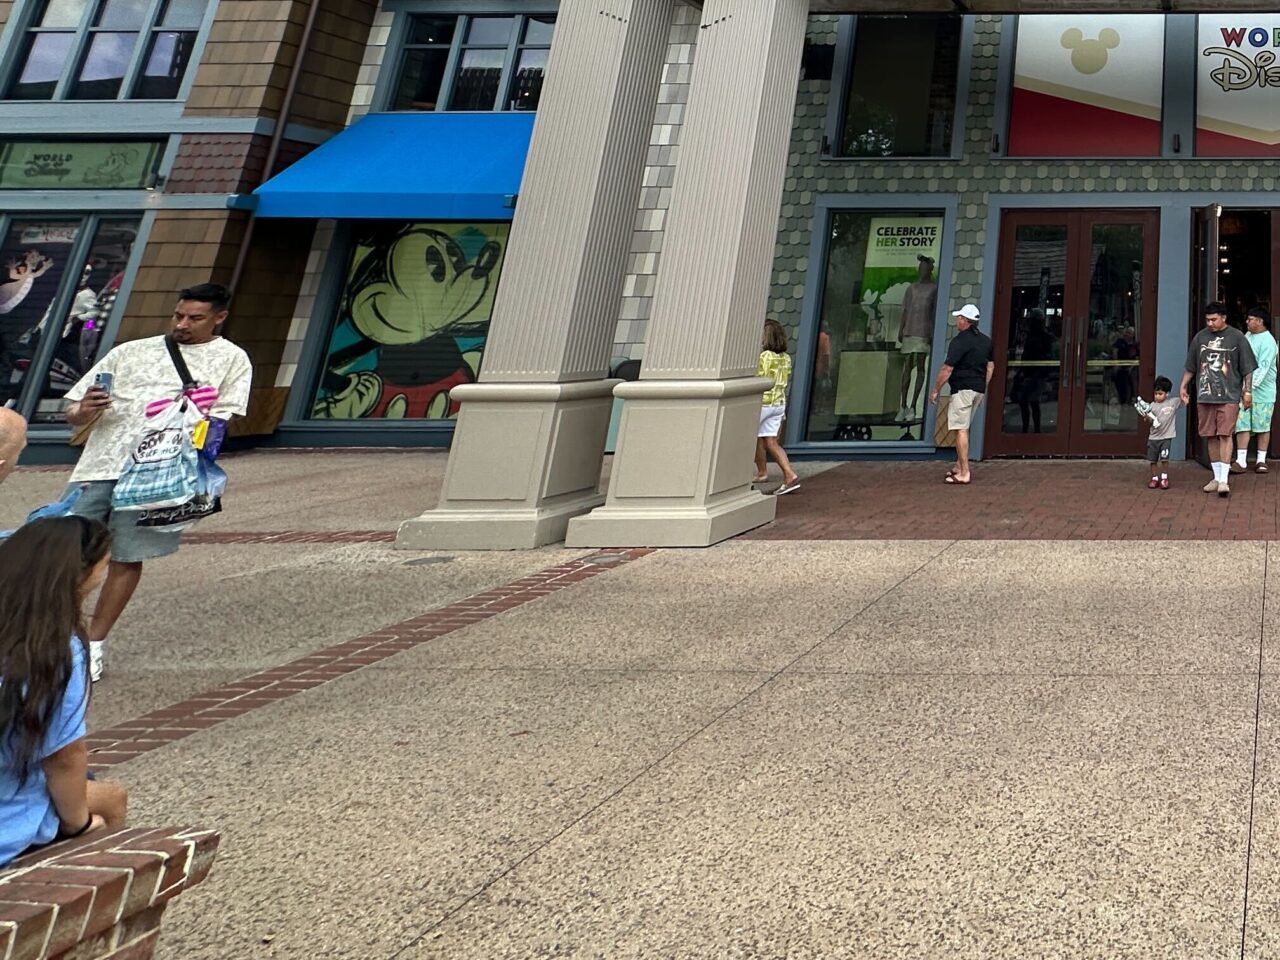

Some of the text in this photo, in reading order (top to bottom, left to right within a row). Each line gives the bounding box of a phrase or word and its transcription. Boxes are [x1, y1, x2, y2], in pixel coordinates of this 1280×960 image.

[877, 227, 937, 237] CELEBRATE
[876, 237, 936, 247] HER STORY
